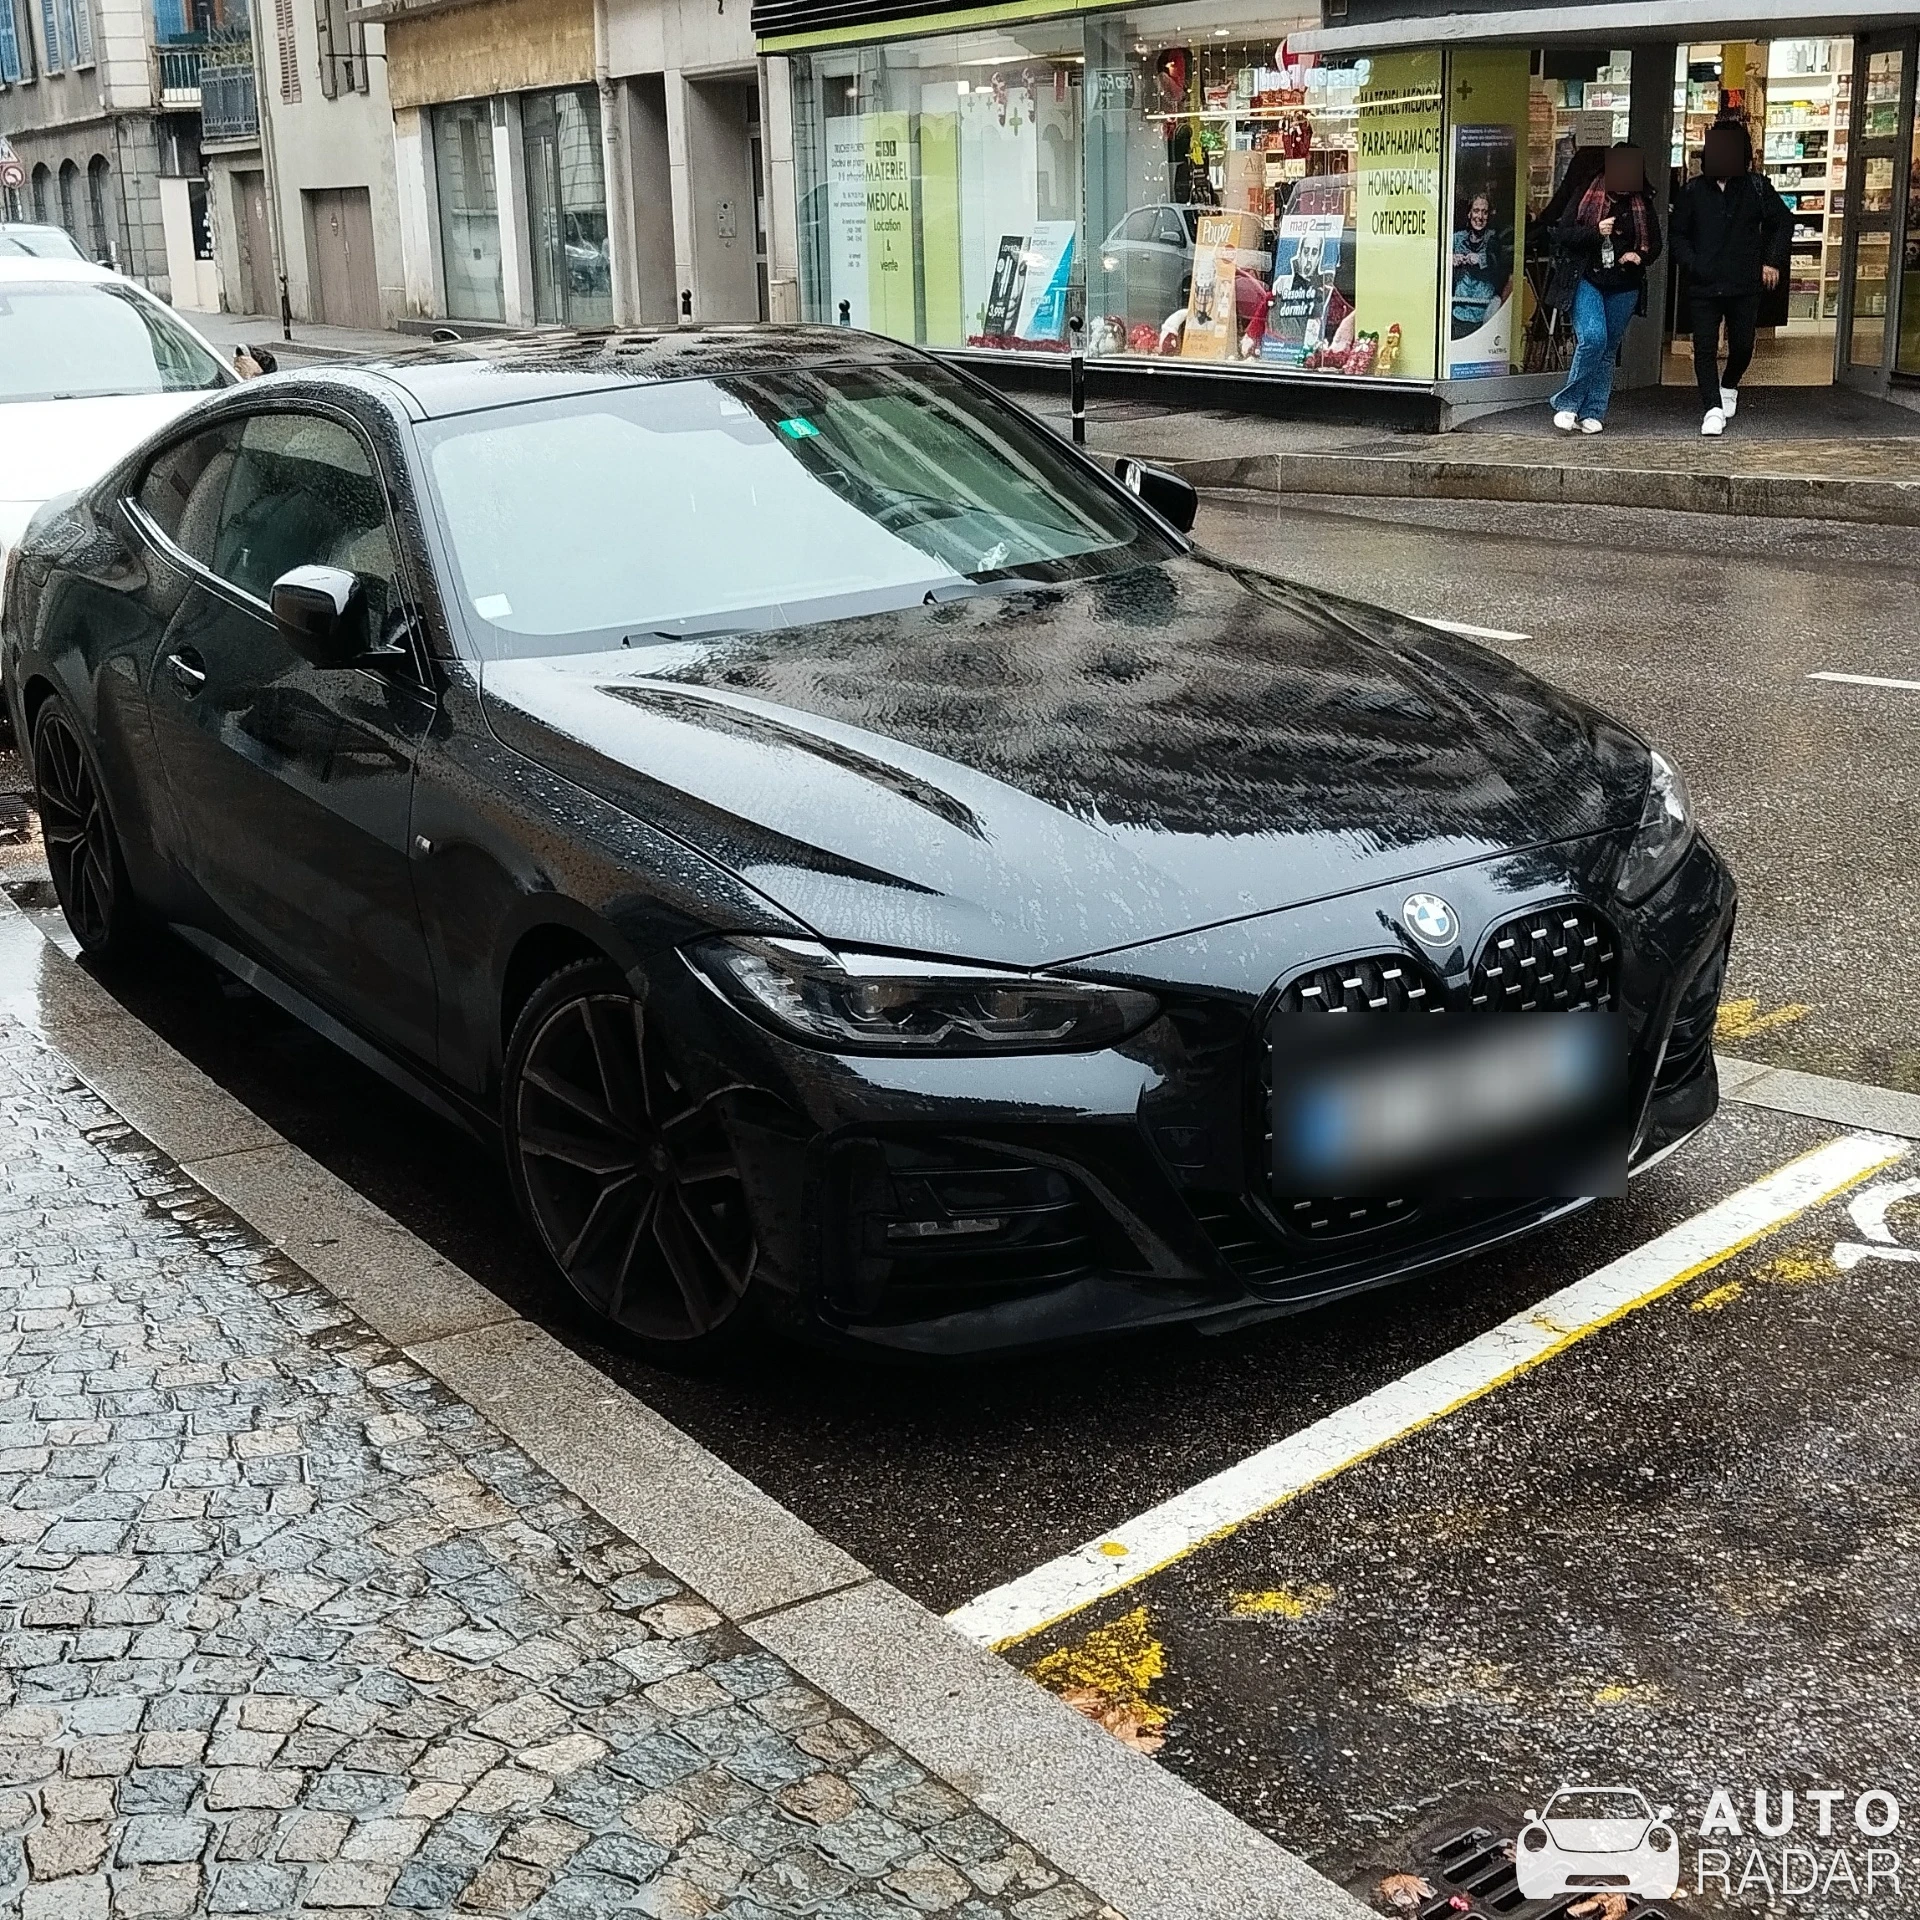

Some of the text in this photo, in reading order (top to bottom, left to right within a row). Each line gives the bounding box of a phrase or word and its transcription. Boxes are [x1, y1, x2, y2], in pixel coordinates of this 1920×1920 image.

[1362, 128, 1439, 157] PARAPHARMACIE
[865, 161, 908, 182] MATERIEL
[1368, 169, 1431, 196] HOMEOPATHIE
[866, 192, 909, 211] MEDICAL
[873, 218, 901, 231] Location
[1290, 220, 1308, 235] mag
[1372, 210, 1426, 235] ORTHOPEDIE
[880, 258, 898, 271] vente
[1282, 286, 1316, 300] Besoin de
[1280, 301, 1307, 316] dormir
